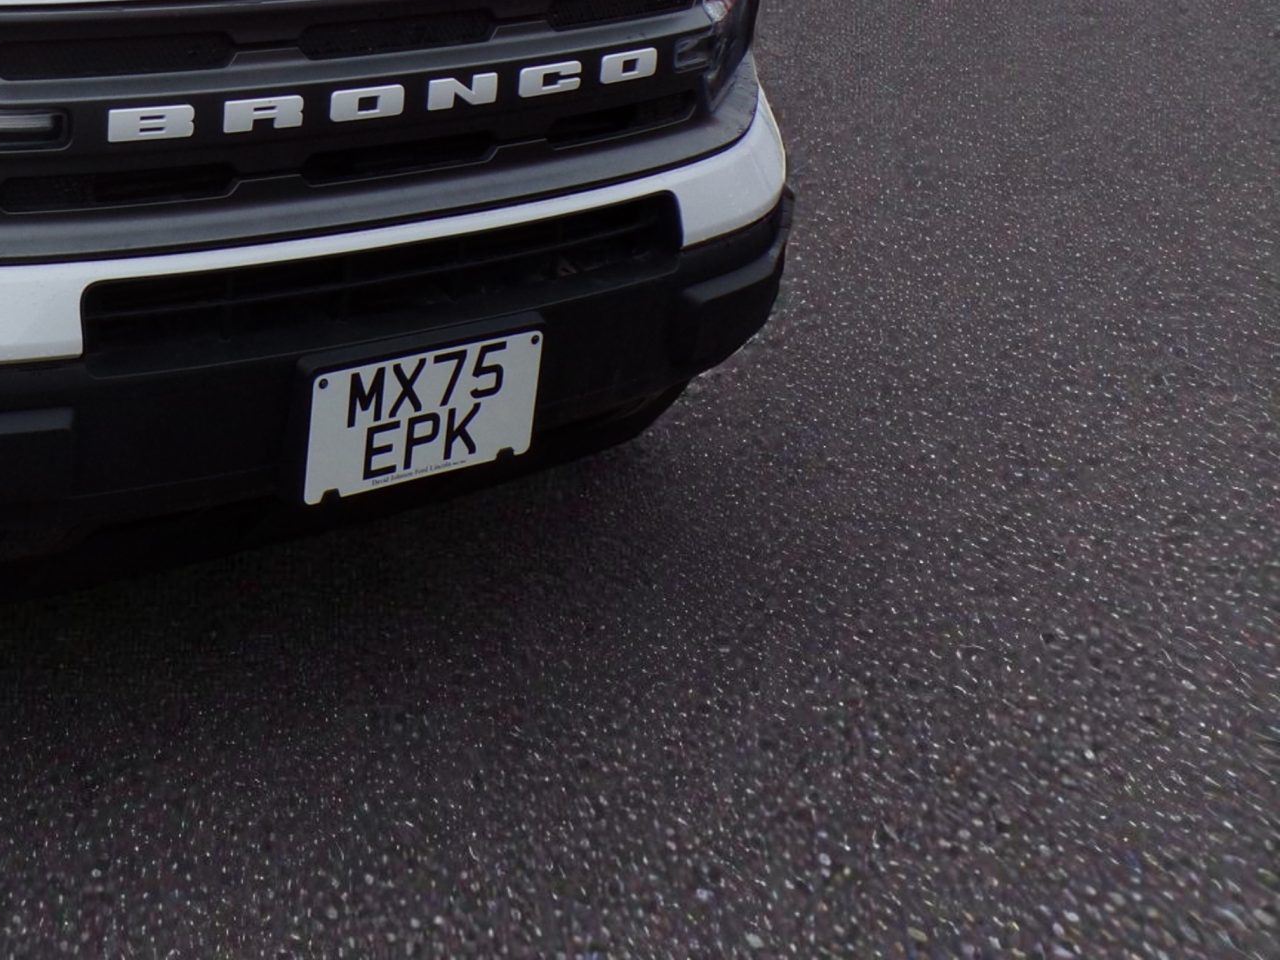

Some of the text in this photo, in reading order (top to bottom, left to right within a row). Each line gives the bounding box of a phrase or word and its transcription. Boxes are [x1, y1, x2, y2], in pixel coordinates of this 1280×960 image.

[107, 47, 657, 143] BRONCO
[346, 341, 507, 429] MX75
[362, 402, 482, 481] EPK
